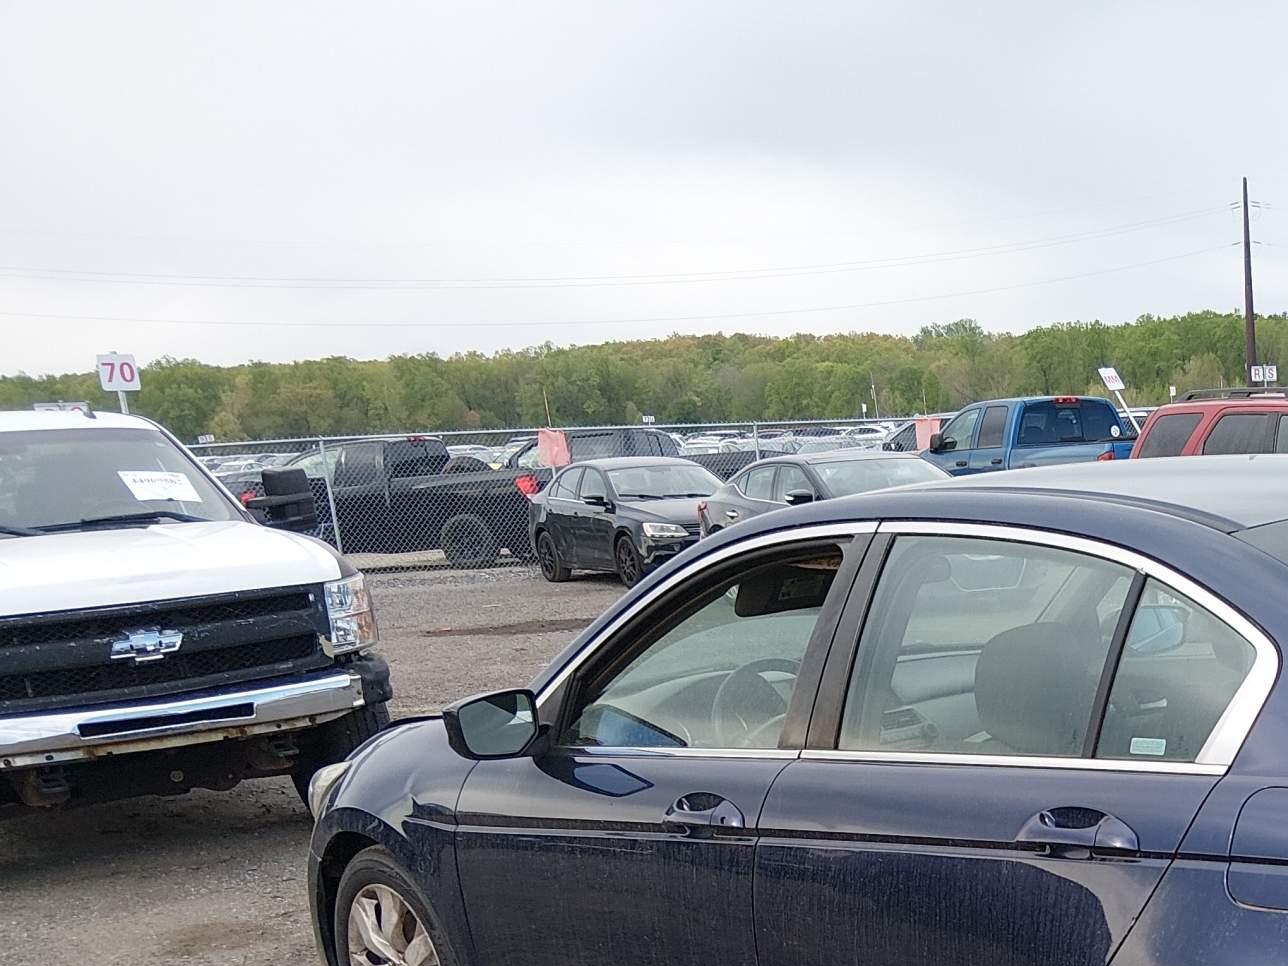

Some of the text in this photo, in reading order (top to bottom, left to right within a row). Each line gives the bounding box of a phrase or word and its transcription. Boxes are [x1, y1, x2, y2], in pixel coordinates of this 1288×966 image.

[100, 362, 135, 383] 70
[1253, 368, 1261, 380] R
[1267, 368, 1274, 379] S
